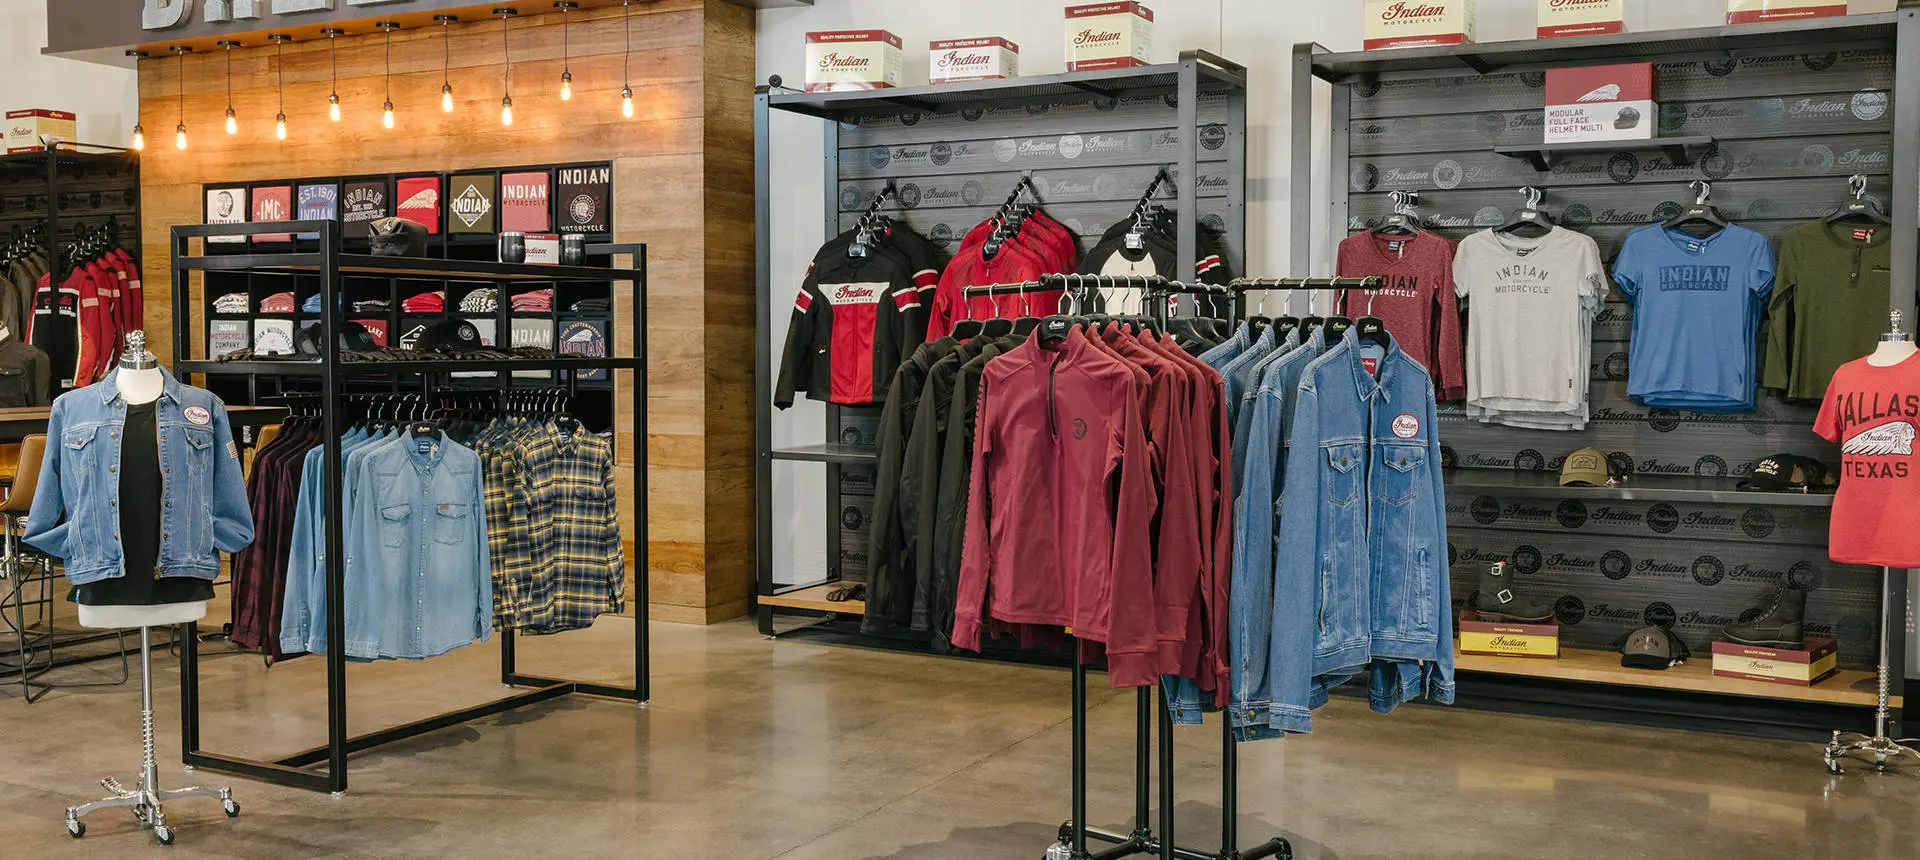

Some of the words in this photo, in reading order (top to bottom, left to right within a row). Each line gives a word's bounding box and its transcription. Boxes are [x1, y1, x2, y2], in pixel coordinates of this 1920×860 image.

[1381, 1, 1445, 20] Indian
[1383, 17, 1443, 25] MOTORCYCLE
[1073, 29, 1121, 44] Indian
[819, 52, 869, 67] Indian
[937, 51, 991, 67] Indian
[1549, 109, 1584, 117] MODULAR
[1790, 99, 1846, 114] Indian
[1549, 118, 1568, 126] FULL
[1570, 116, 1589, 124] FACE
[1549, 125, 1578, 133] HELMET
[1580, 123, 1603, 132] MULTI
[892, 147, 927, 160] Indian
[1018, 140, 1057, 154] Indian
[1383, 167, 1429, 181] Indian
[1551, 162, 1601, 176] Indian
[559, 168, 610, 185] INDIAN
[343, 187, 383, 209] INDIAN
[503, 184, 546, 198] INDIAN
[924, 187, 959, 200] Indian
[260, 199, 281, 220] IMC
[453, 198, 489, 213] INDIAN
[1424, 214, 1470, 228] Indian
[1597, 208, 1648, 223] Indian
[560, 224, 604, 232] MOTORCYCLE
[1496, 264, 1549, 281] INDIAN
[1660, 267, 1730, 282] INDIAN
[835, 285, 873, 299] Indian
[1495, 285, 1549, 294] MOTORCYCLE
[1661, 282, 1728, 291] MOTORCYCLE
[1596, 309, 1634, 323] Indi
[368, 326, 383, 339] LAKE
[512, 329, 550, 343] NDIAN
[559, 337, 605, 359] INDIAN
[1592, 407, 1644, 420] Indian
[1837, 391, 1920, 431] ALLAS
[1860, 431, 1893, 442] Indian
[1463, 453, 1511, 467] Indian
[1637, 458, 1690, 474] Indian
[1844, 460, 1909, 478] TEXAS
[1503, 503, 1552, 517] Indian
[1591, 505, 1642, 520] Indian
[1683, 511, 1736, 525] Indian
[1546, 552, 1596, 567] Indian
[1635, 558, 1687, 573] Indian
[1729, 564, 1784, 580] Indian
[1589, 603, 1639, 618] Indian
[1680, 610, 1732, 625] Indian
[1490, 635, 1528, 647] Indian
